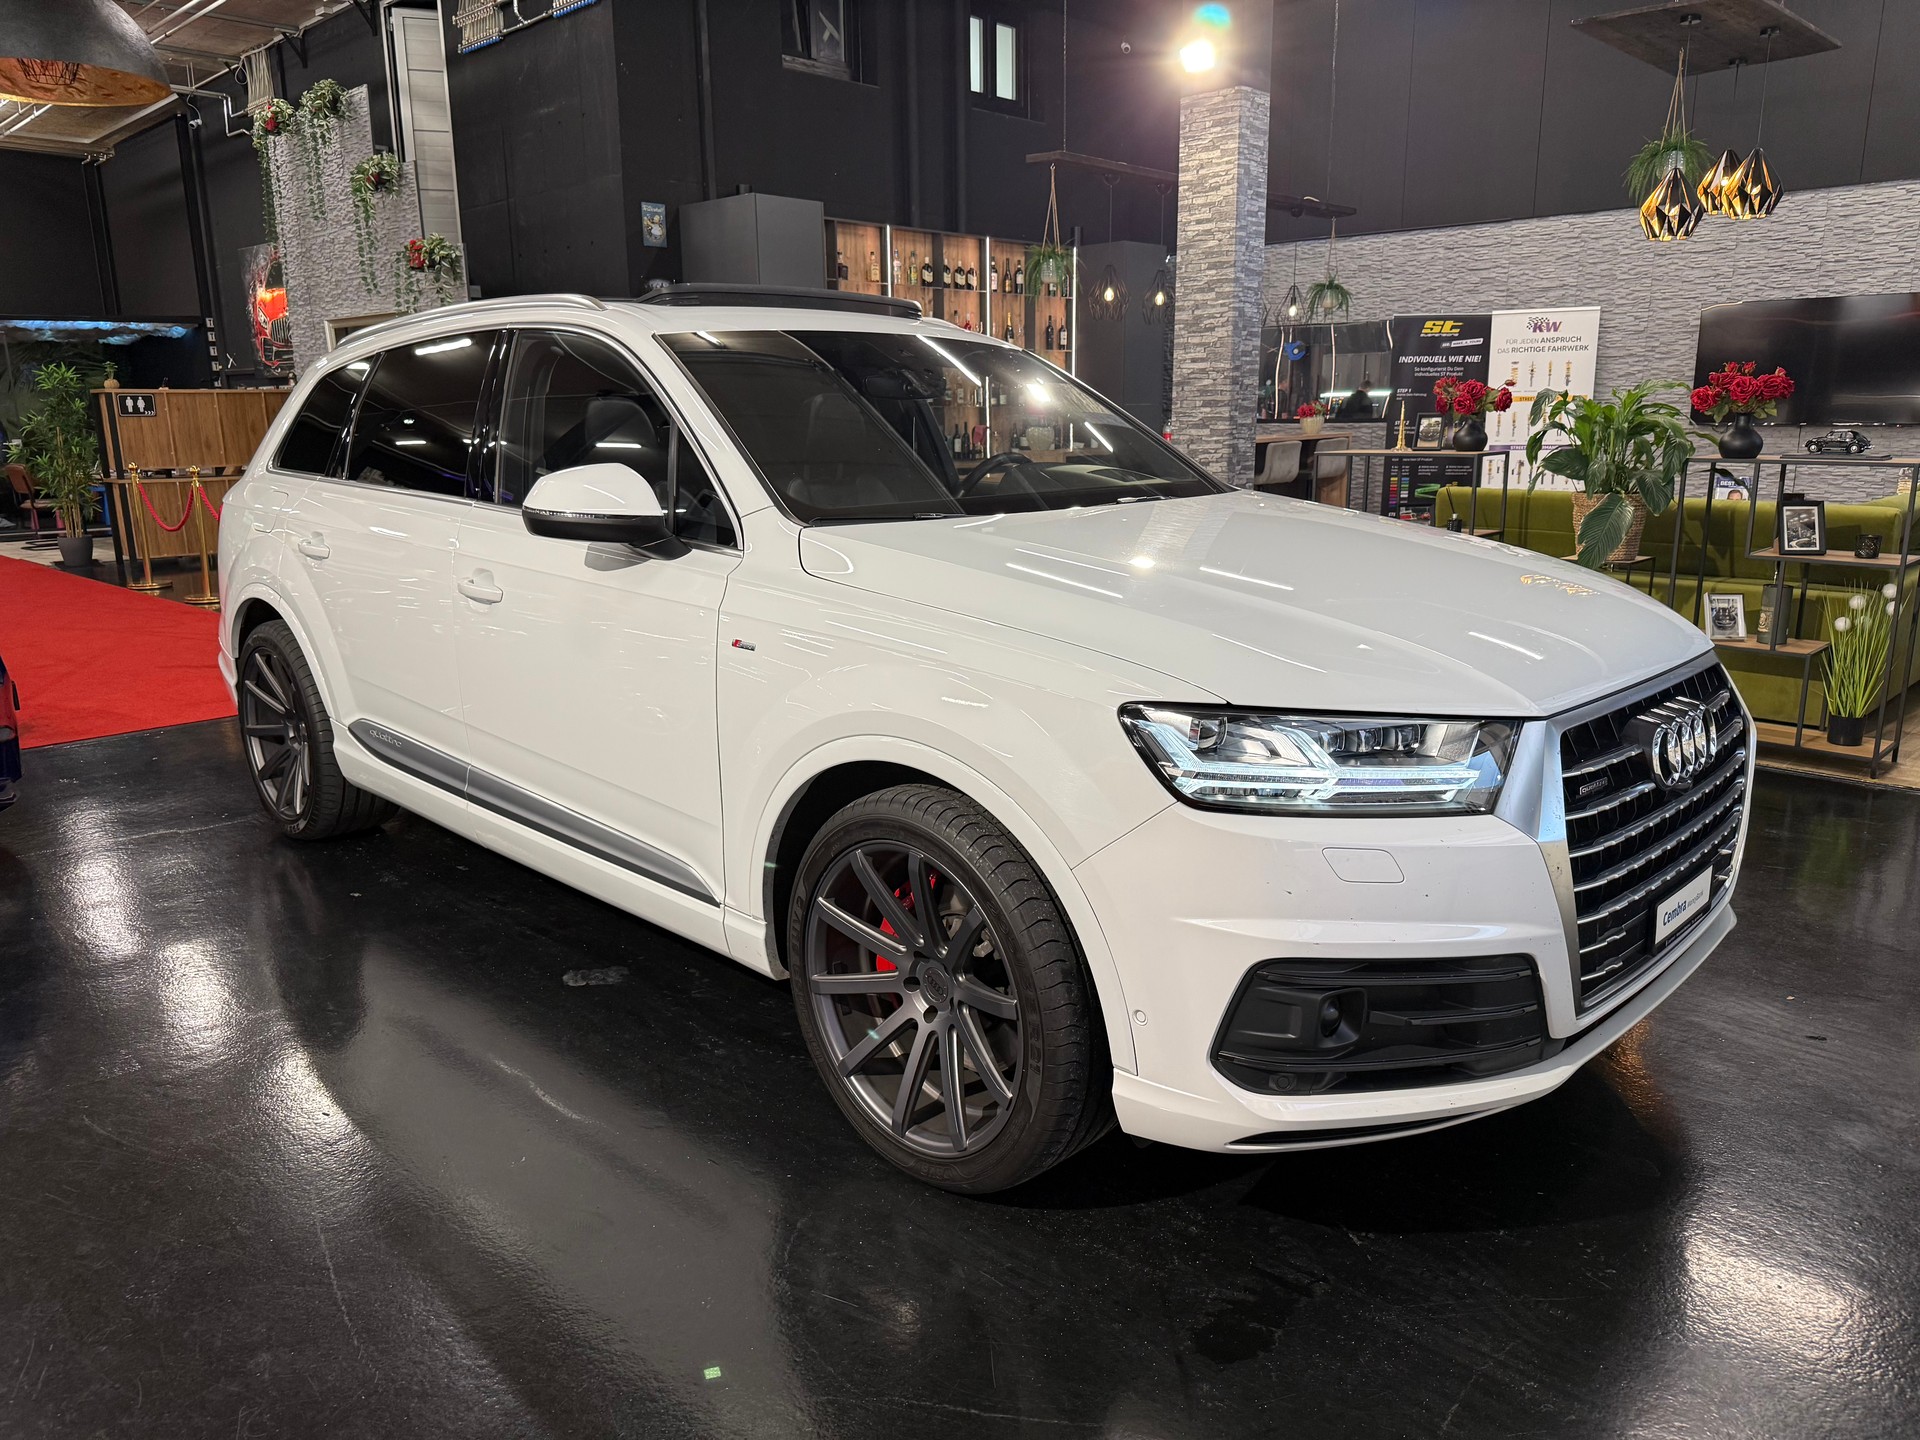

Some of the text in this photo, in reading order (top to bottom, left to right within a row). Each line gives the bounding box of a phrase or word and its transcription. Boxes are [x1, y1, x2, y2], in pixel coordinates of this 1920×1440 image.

[1532, 321, 1562, 333] KW
[1505, 336, 1582, 345] FÜR JEDEN ANSPRUCH
[1547, 345, 1590, 353] FAHRWERK
[1398, 354, 1482, 364] INDIVIDUELL WIE NIE!
[369, 729, 402, 748] quattro
[1662, 900, 1687, 927] Cembra
